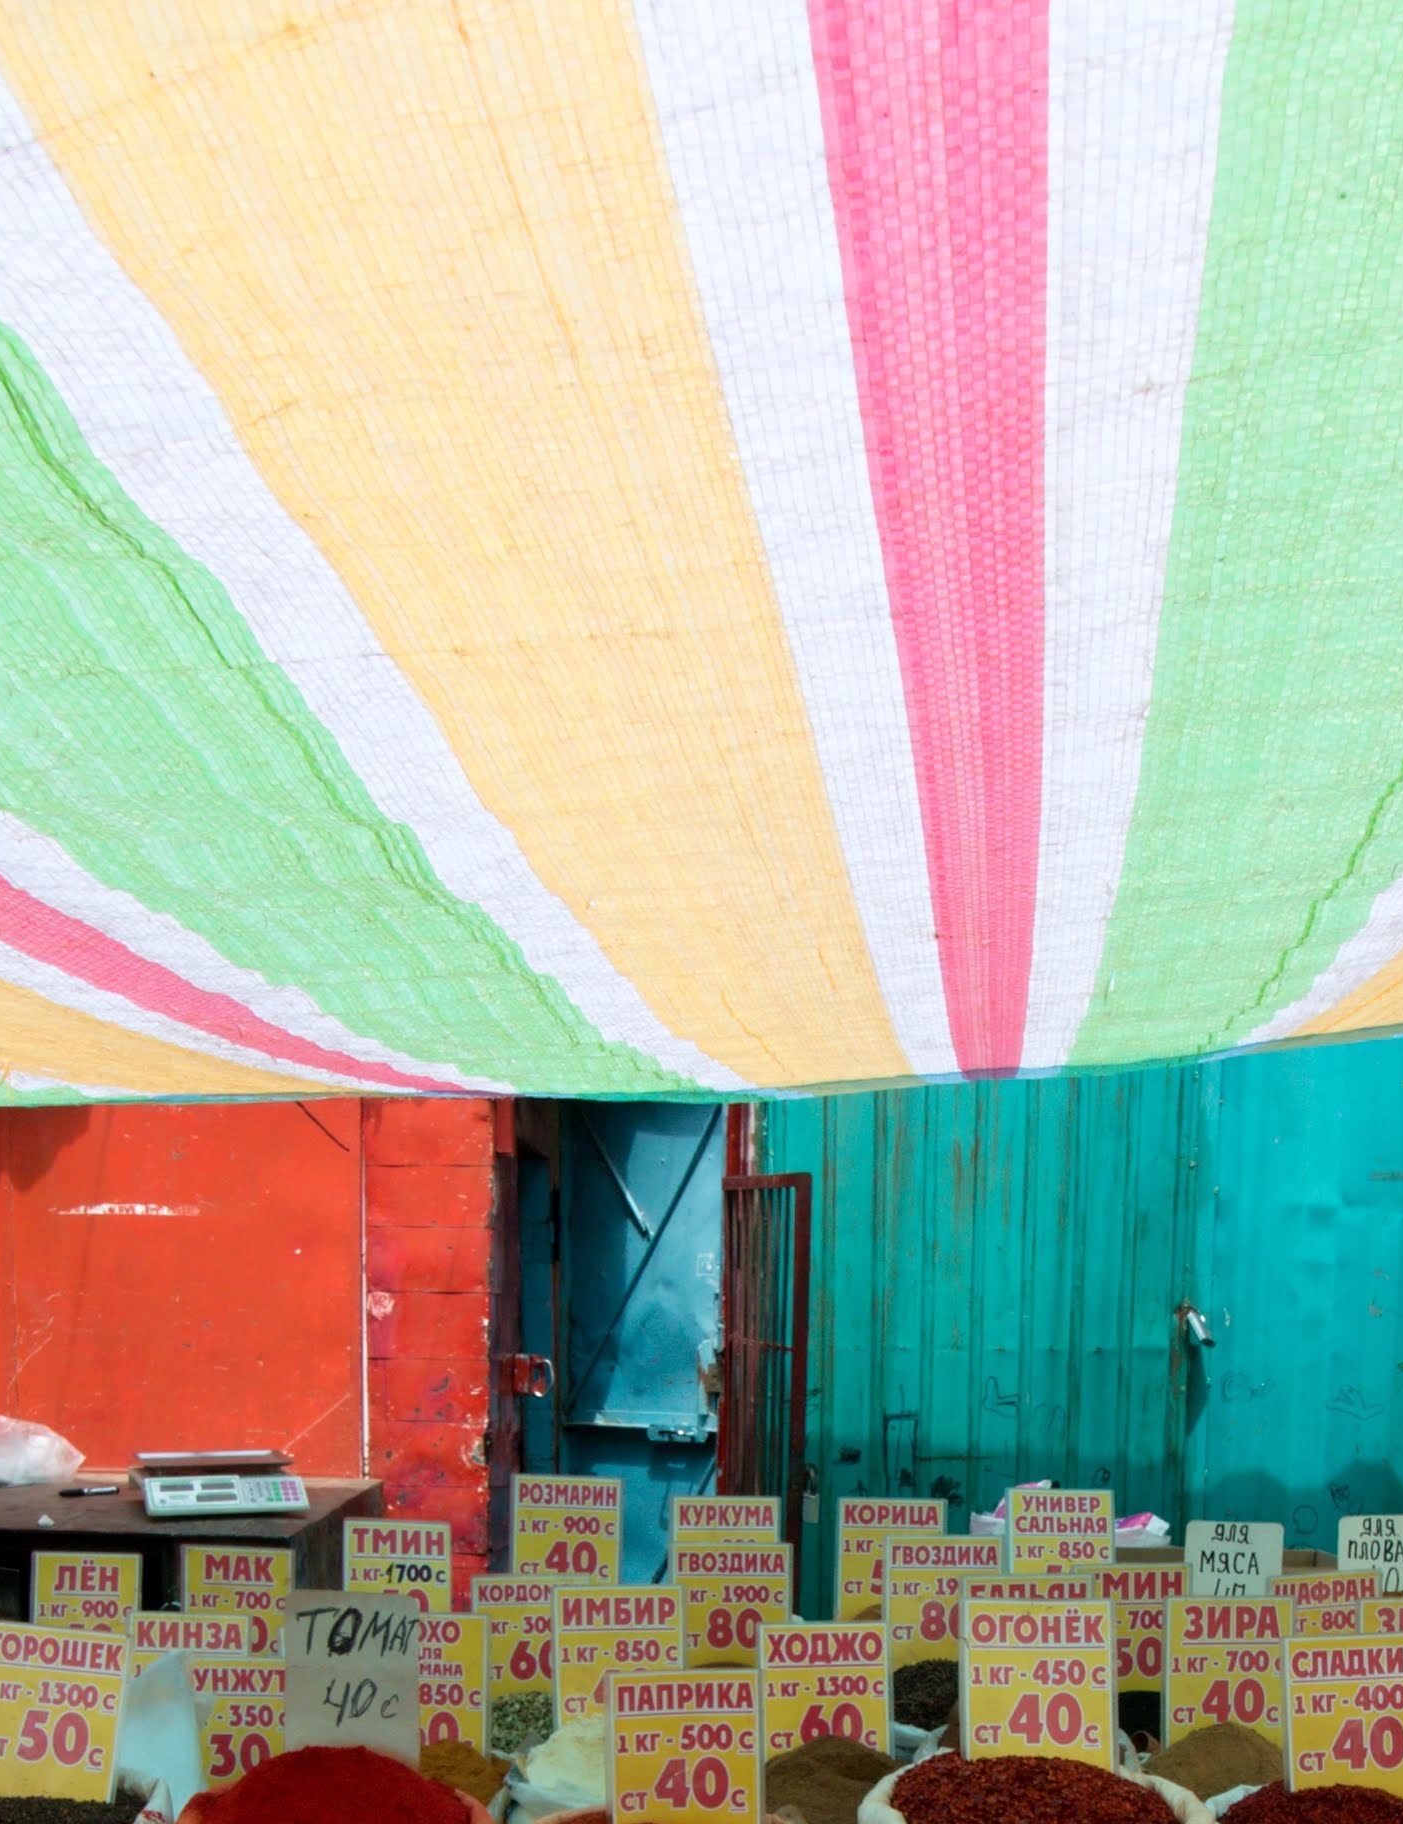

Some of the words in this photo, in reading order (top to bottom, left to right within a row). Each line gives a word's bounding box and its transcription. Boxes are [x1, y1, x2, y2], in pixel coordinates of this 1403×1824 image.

[520, 1483, 616, 1504] РОЗМАРИН
[1025, 1498, 1098, 1512] УНИВЕР
[564, 1517, 600, 1534] 900
[680, 1505, 773, 1524] КУРКУМА
[845, 1505, 938, 1526] КОРИЦА
[1016, 1517, 1106, 1533] САЛЬНАЯ
[353, 1528, 444, 1555] ТМИН
[1060, 1542, 1094, 1559] 850
[546, 1542, 597, 1573] 40
[678, 1553, 784, 1572] ГВОЗДИКА
[893, 1546, 997, 1565] ГВОЗДИКА
[1200, 1550, 1259, 1575] МЯСА
[55, 1560, 118, 1591] ЛЁН
[206, 1555, 272, 1582] МАК
[723, 1586, 769, 1603] 1900
[938, 1579, 958, 1595] 19
[1096, 1572, 1182, 1599] МИН
[1275, 1578, 1374, 1604] ШАФРАН
[82, 1600, 118, 1618] 900
[237, 1592, 271, 1609] 700
[563, 1597, 675, 1625] ИМБИР
[138, 1621, 241, 1648] КИНЗА
[420, 1621, 460, 1643] ХО
[707, 1609, 762, 1648] 80
[972, 1608, 1102, 1643] ОГОНЁК
[1184, 1606, 1279, 1639] ЗИРА
[615, 1640, 660, 1662] 850
[769, 1632, 882, 1664] ХОДЖО
[420, 1664, 462, 1675] МАНА
[972, 1667, 983, 1686] 1
[1033, 1660, 1085, 1685] 450
[1227, 1651, 1269, 1672] 700
[194, 1669, 286, 1691] УНЖУТ
[767, 1681, 775, 1696] 1
[816, 1676, 868, 1696] 1300
[39, 1683, 98, 1708] 1300
[323, 1678, 377, 1727] 40
[618, 1683, 753, 1712] ПАПРИКА
[1202, 1679, 1264, 1724] 40
[1296, 1696, 1304, 1714] 1
[231, 1705, 273, 1727] 350
[800, 1703, 862, 1744] 60
[1009, 1693, 1081, 1744] 40
[18, 1711, 88, 1764] 50
[618, 1736, 628, 1753] 1
[681, 1724, 732, 1750] 500
[211, 1734, 275, 1781] 30
[655, 1757, 728, 1808] 40
